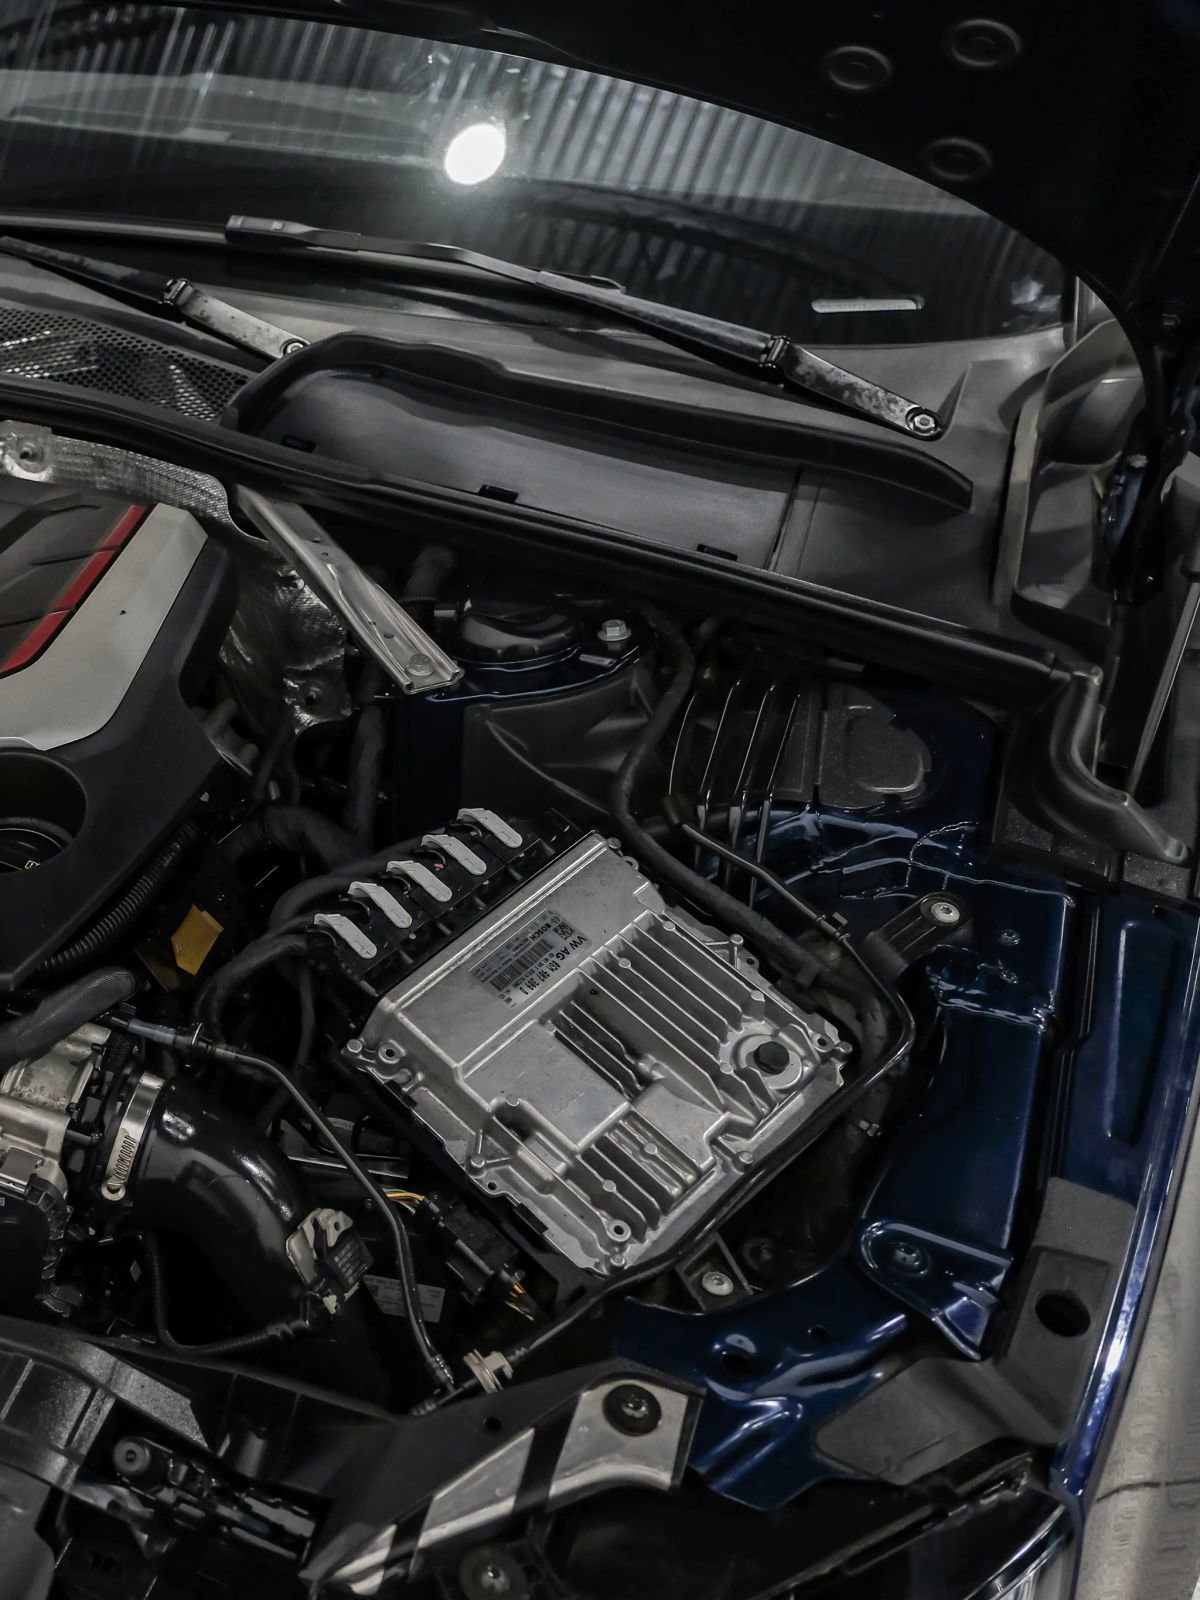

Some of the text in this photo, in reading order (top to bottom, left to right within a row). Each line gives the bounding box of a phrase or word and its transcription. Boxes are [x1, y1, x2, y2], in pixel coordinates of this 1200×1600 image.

[529, 923, 552, 941] BOSCH
[569, 935, 588, 951] VW
[556, 949, 571, 961] AG
